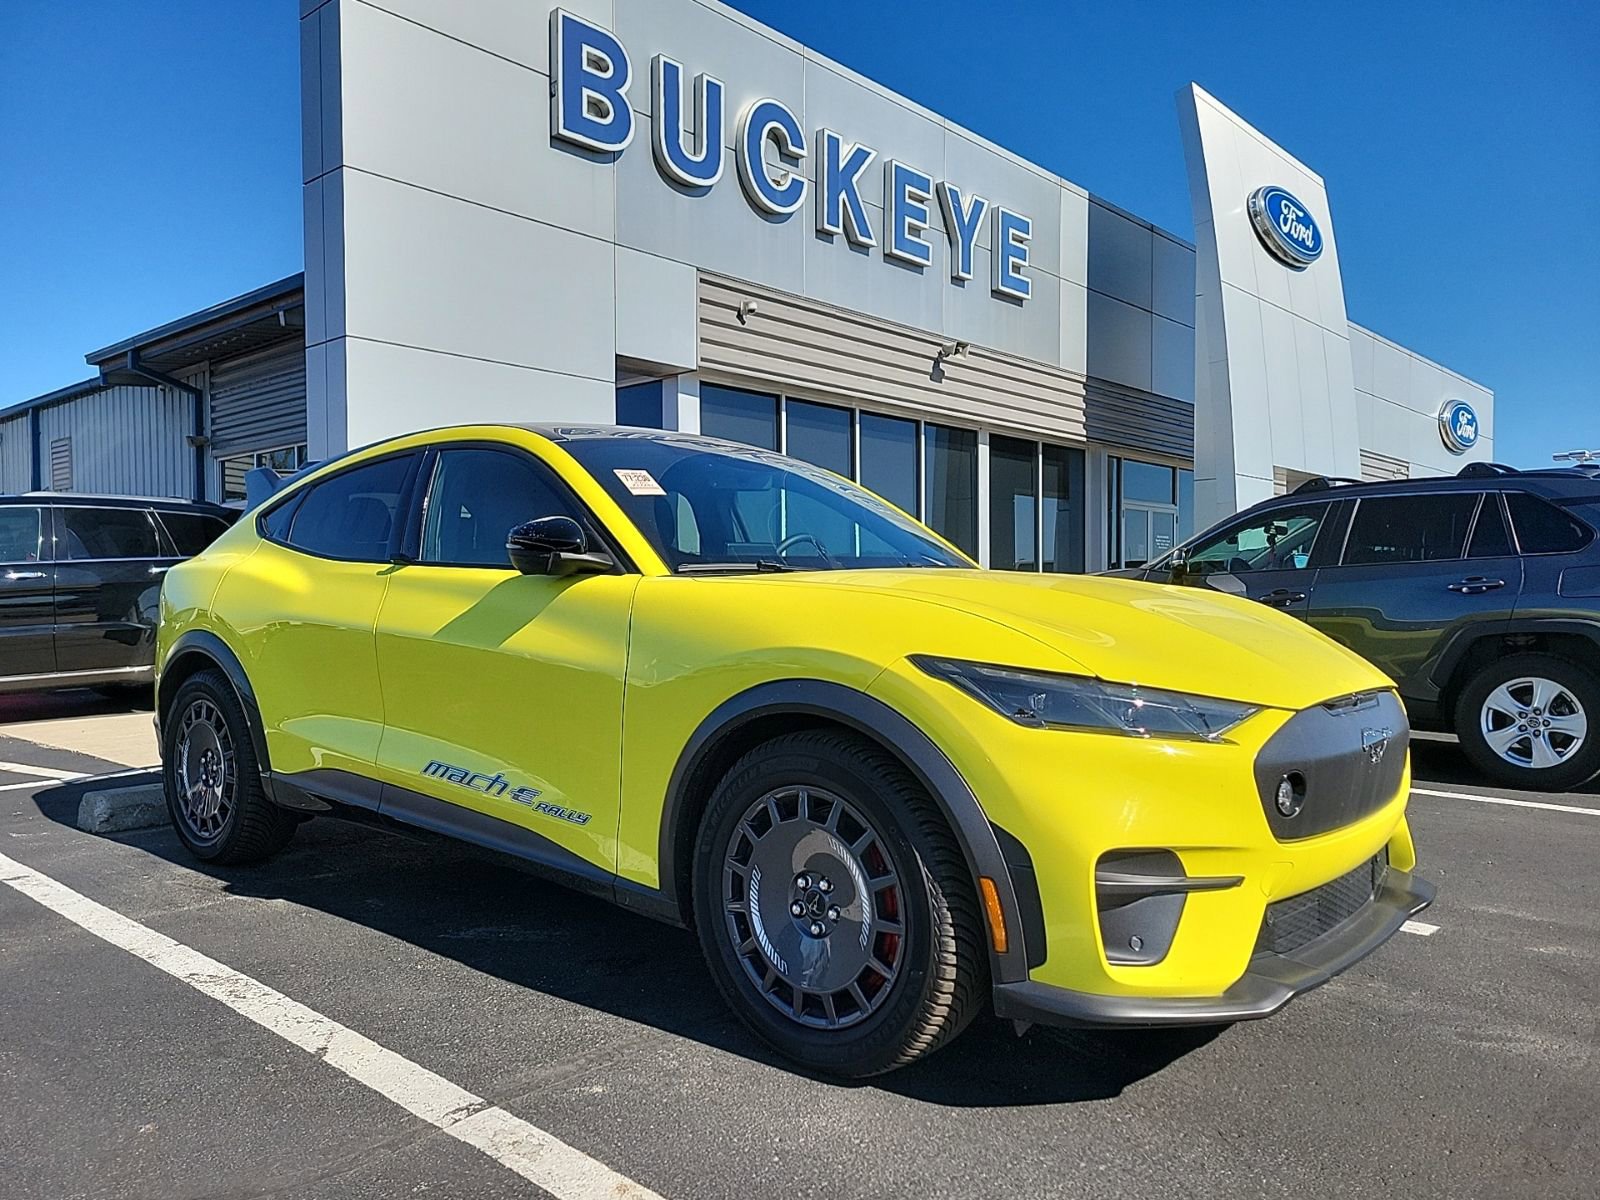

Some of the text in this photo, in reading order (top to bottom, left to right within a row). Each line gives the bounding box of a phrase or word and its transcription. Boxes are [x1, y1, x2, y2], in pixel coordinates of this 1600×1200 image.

[550, 8, 1033, 301] BUCKEYE
[1280, 199, 1315, 249] Ford
[1456, 410, 1477, 440] Ford
[532, 802, 592, 825] RALLY
